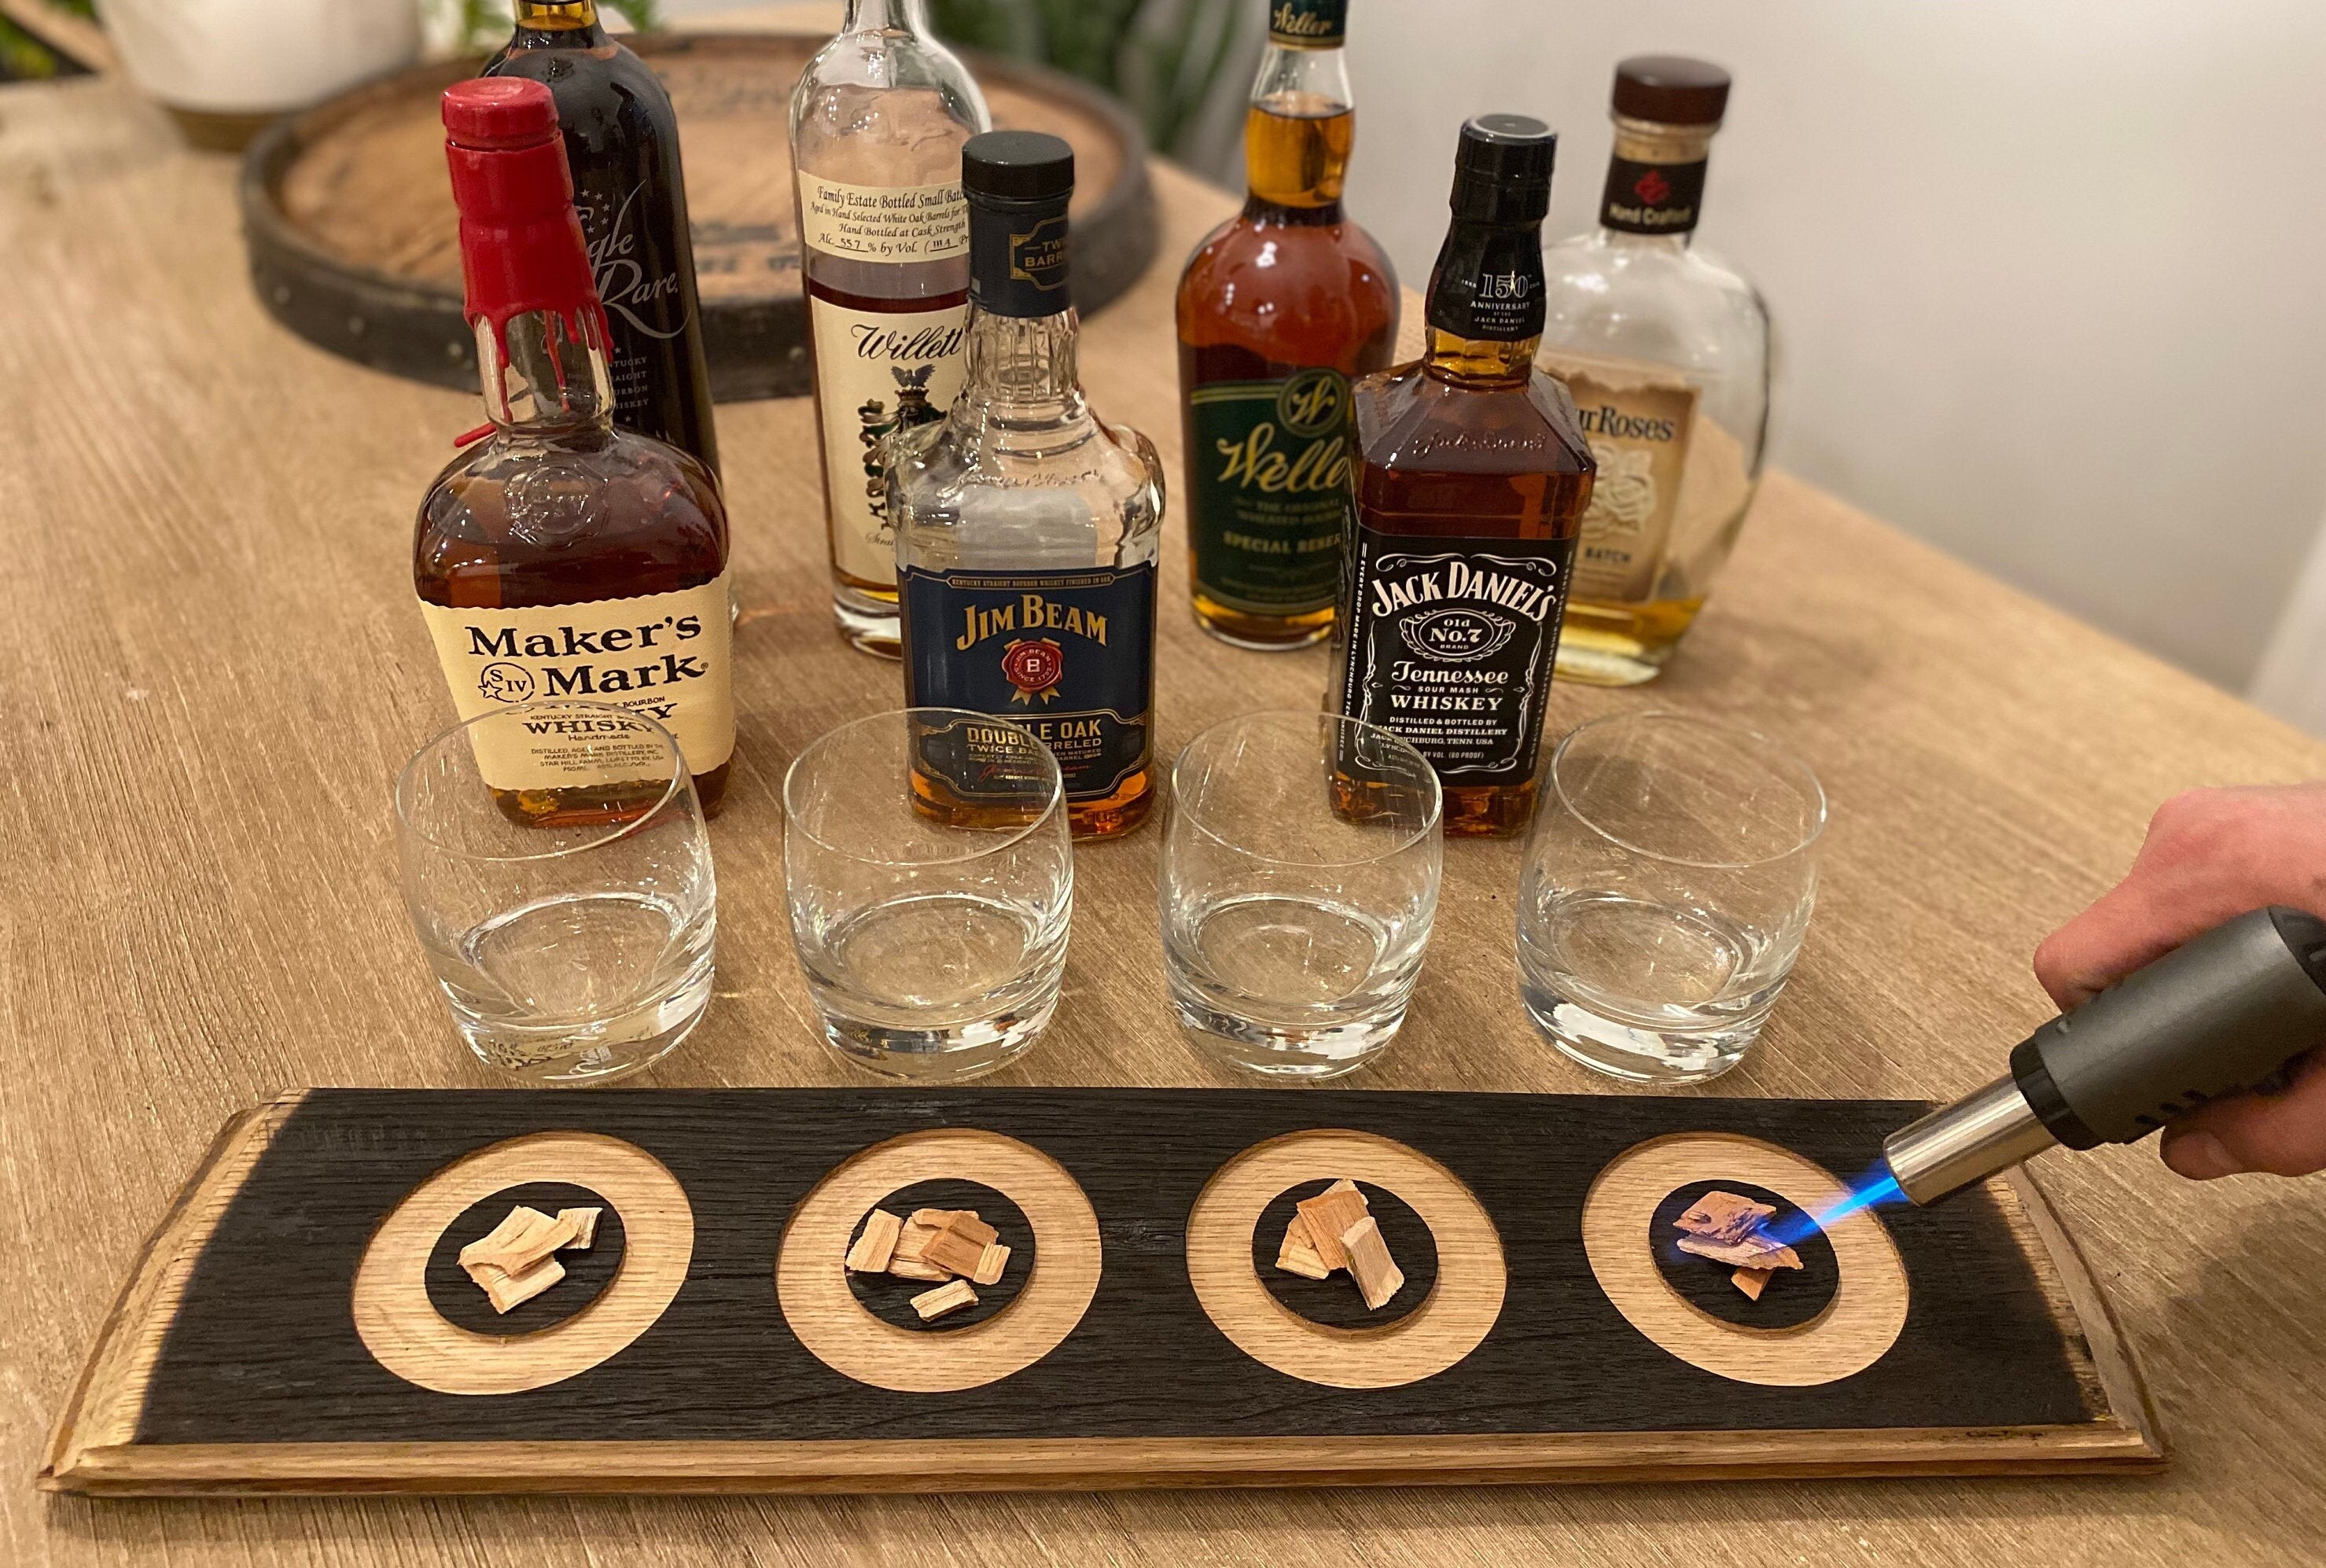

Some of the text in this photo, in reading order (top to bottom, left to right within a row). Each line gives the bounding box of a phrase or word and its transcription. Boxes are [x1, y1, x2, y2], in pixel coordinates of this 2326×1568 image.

[818, 186, 966, 208] Family Estate Bottled Small Batc
[811, 202, 823, 215] Aged
[832, 208, 851, 221] Hand
[852, 212, 881, 223] Selected
[883, 214, 907, 223] White
[909, 212, 926, 223] Oak
[926, 208, 950, 223] Barrels
[951, 206, 961, 219] for
[839, 220, 966, 237] Hand Bottled at Cask Strength
[880, 242, 892, 256] by
[1470, 300, 1530, 311] ANNIVERSARY
[851, 324, 964, 360] Willett
[610, 356, 647, 368] TUCKY
[613, 371, 647, 382] AIGHT
[614, 385, 648, 396] URBON
[616, 399, 649, 410] ISKEY
[1599, 404, 1675, 442] Roses
[1216, 422, 1349, 493] Welle
[1223, 530, 1341, 554] SPECIAL RESER
[1372, 571, 1441, 617] JACK
[1447, 561, 1557, 622] DANIEL'S
[955, 594, 1108, 650] JIM BEAM
[1444, 618, 1470, 628] Old
[465, 615, 701, 657] Maker's
[1352, 640, 1358, 650] IN
[1027, 659, 1040, 672] B
[1391, 661, 1508, 683] Tennessee
[489, 669, 528, 693] S IV
[541, 653, 706, 698] Mark
[1346, 650, 1357, 699] LYNCHBURG
[1450, 686, 1479, 694] MASH
[623, 695, 665, 708] BOURBON
[1390, 694, 1503, 711] WHISKEY
[1062, 719, 1102, 739] OAK
[1389, 716, 1435, 725] DISTILLED
[568, 733, 631, 742] Handmade
[966, 743, 1014, 753] TWICE
